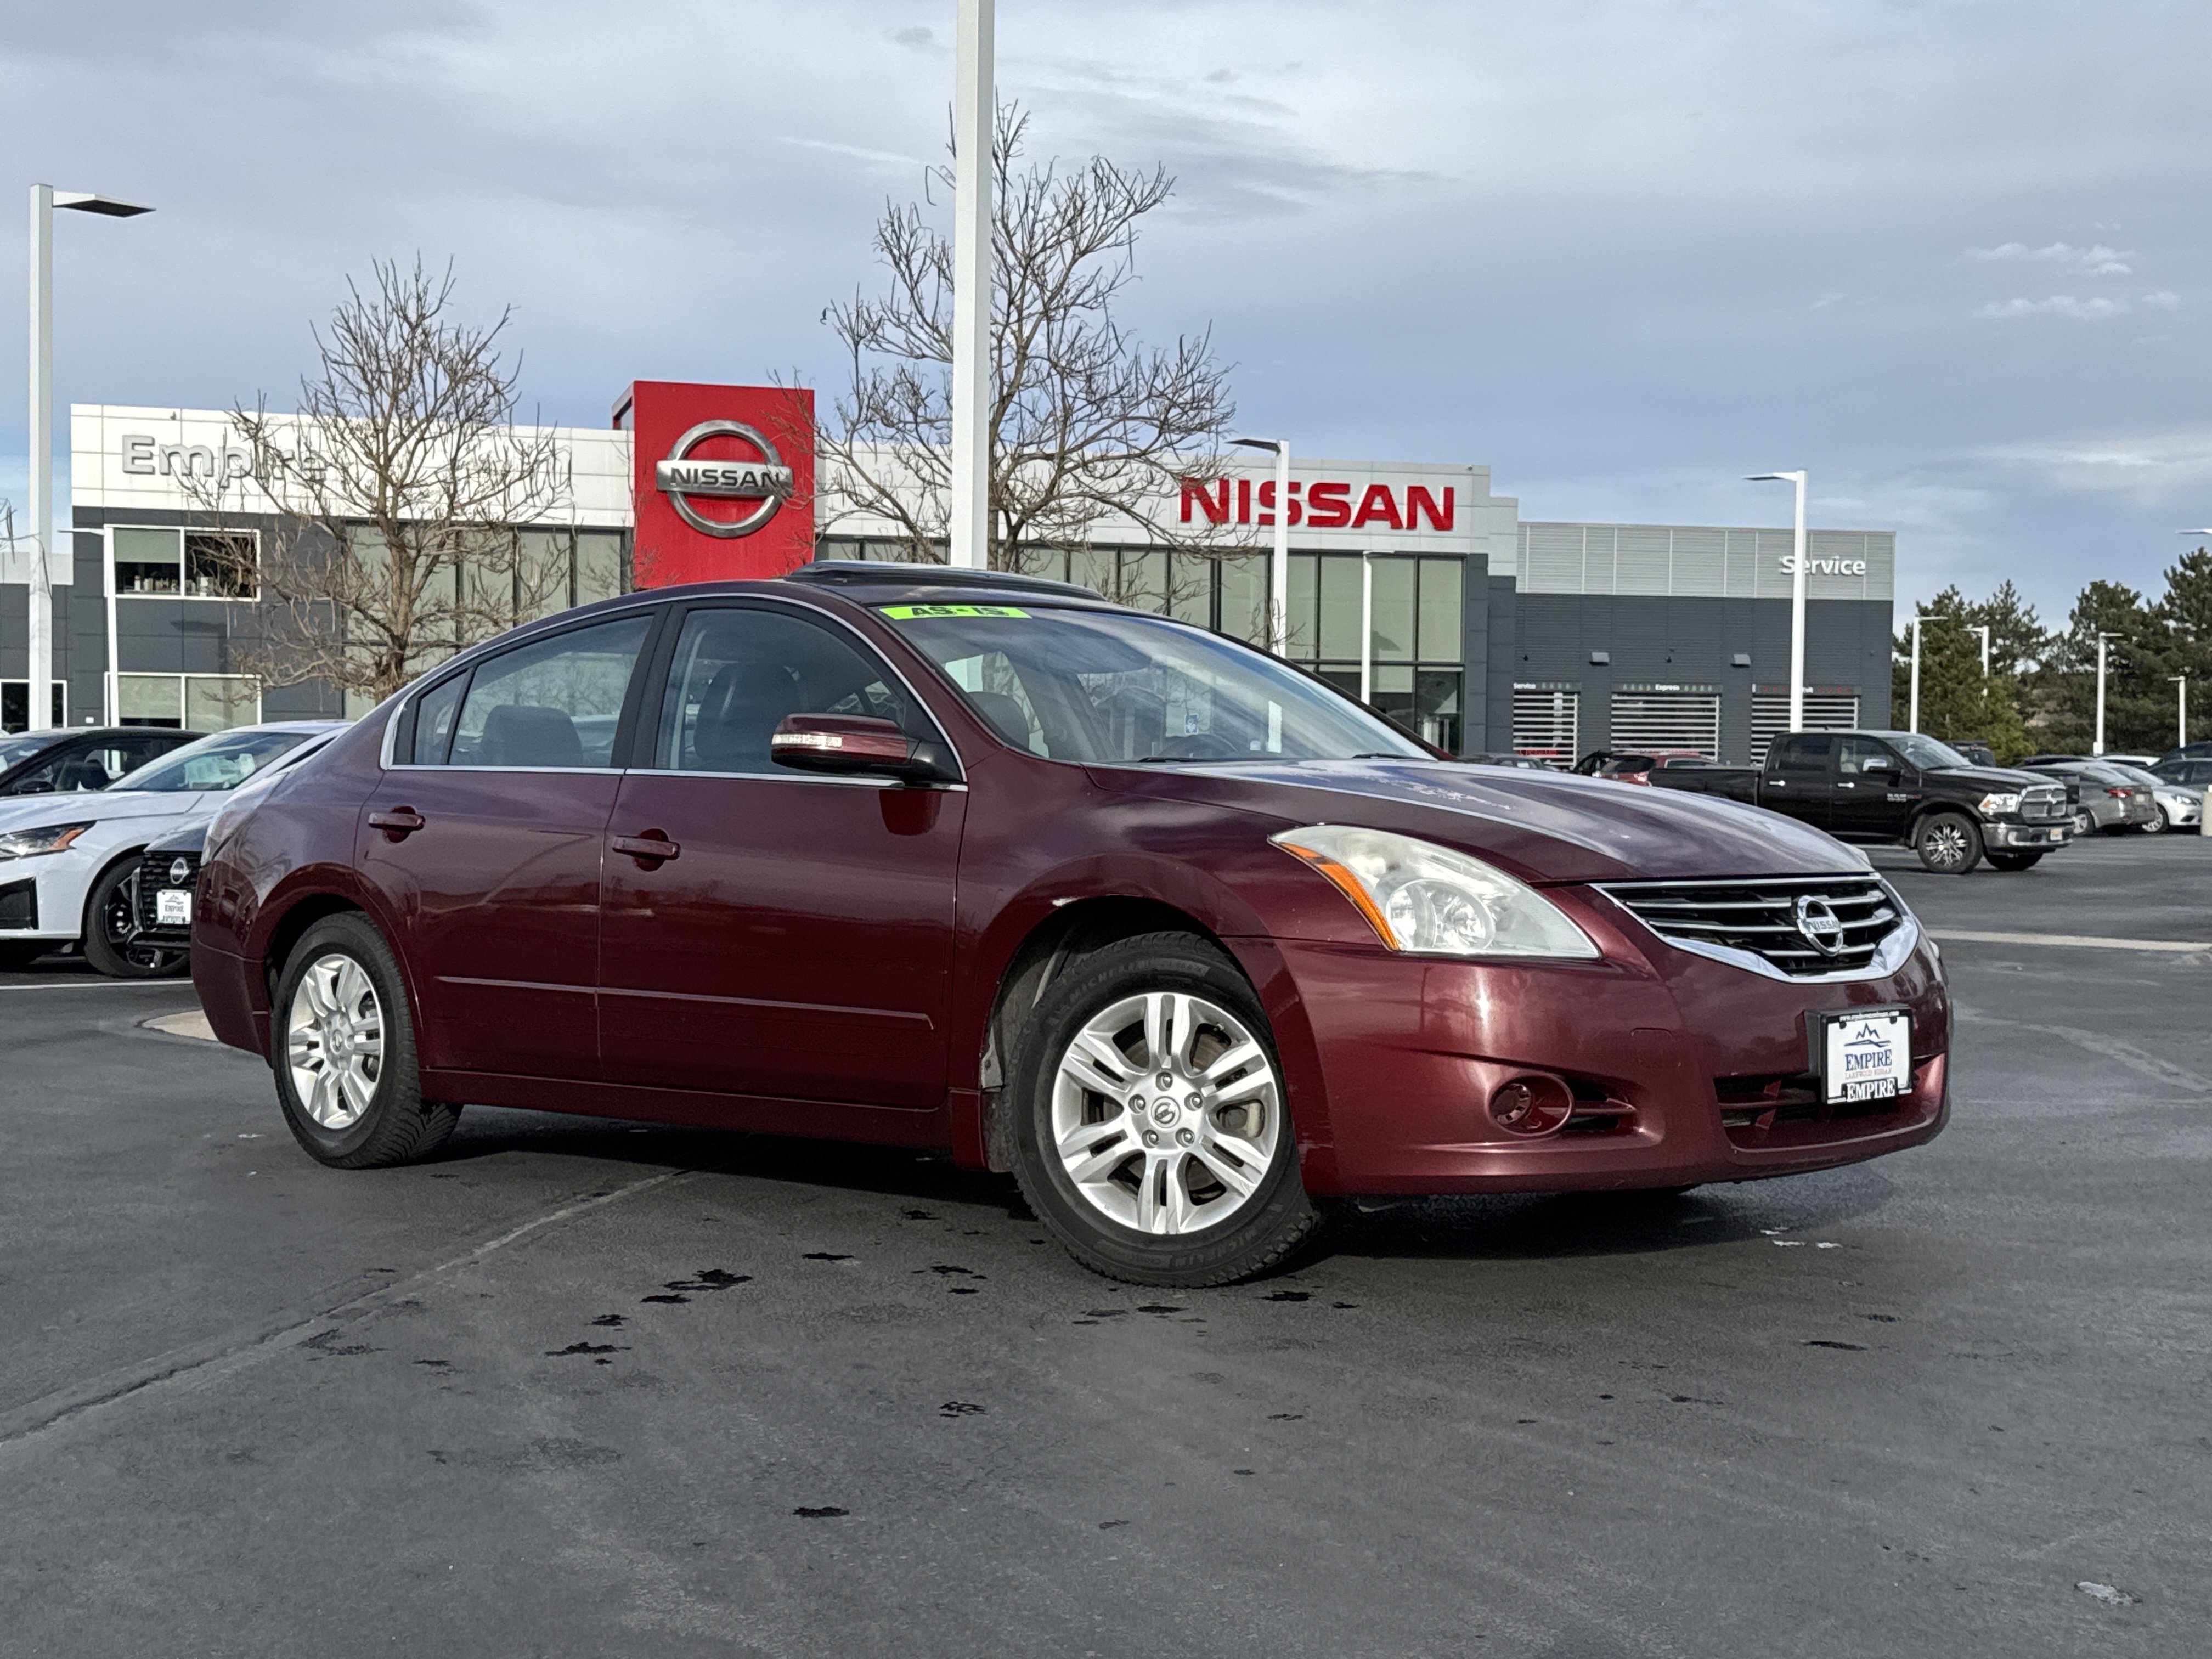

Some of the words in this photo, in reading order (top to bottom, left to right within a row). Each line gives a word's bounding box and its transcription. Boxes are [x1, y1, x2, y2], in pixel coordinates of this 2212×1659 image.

[671, 467, 780, 488] NISSAN
[1179, 476, 1454, 531] NISSAN
[1845, 1049, 1892, 1072] EMPIRE
[1847, 1078, 1895, 1102] EMPIRE
